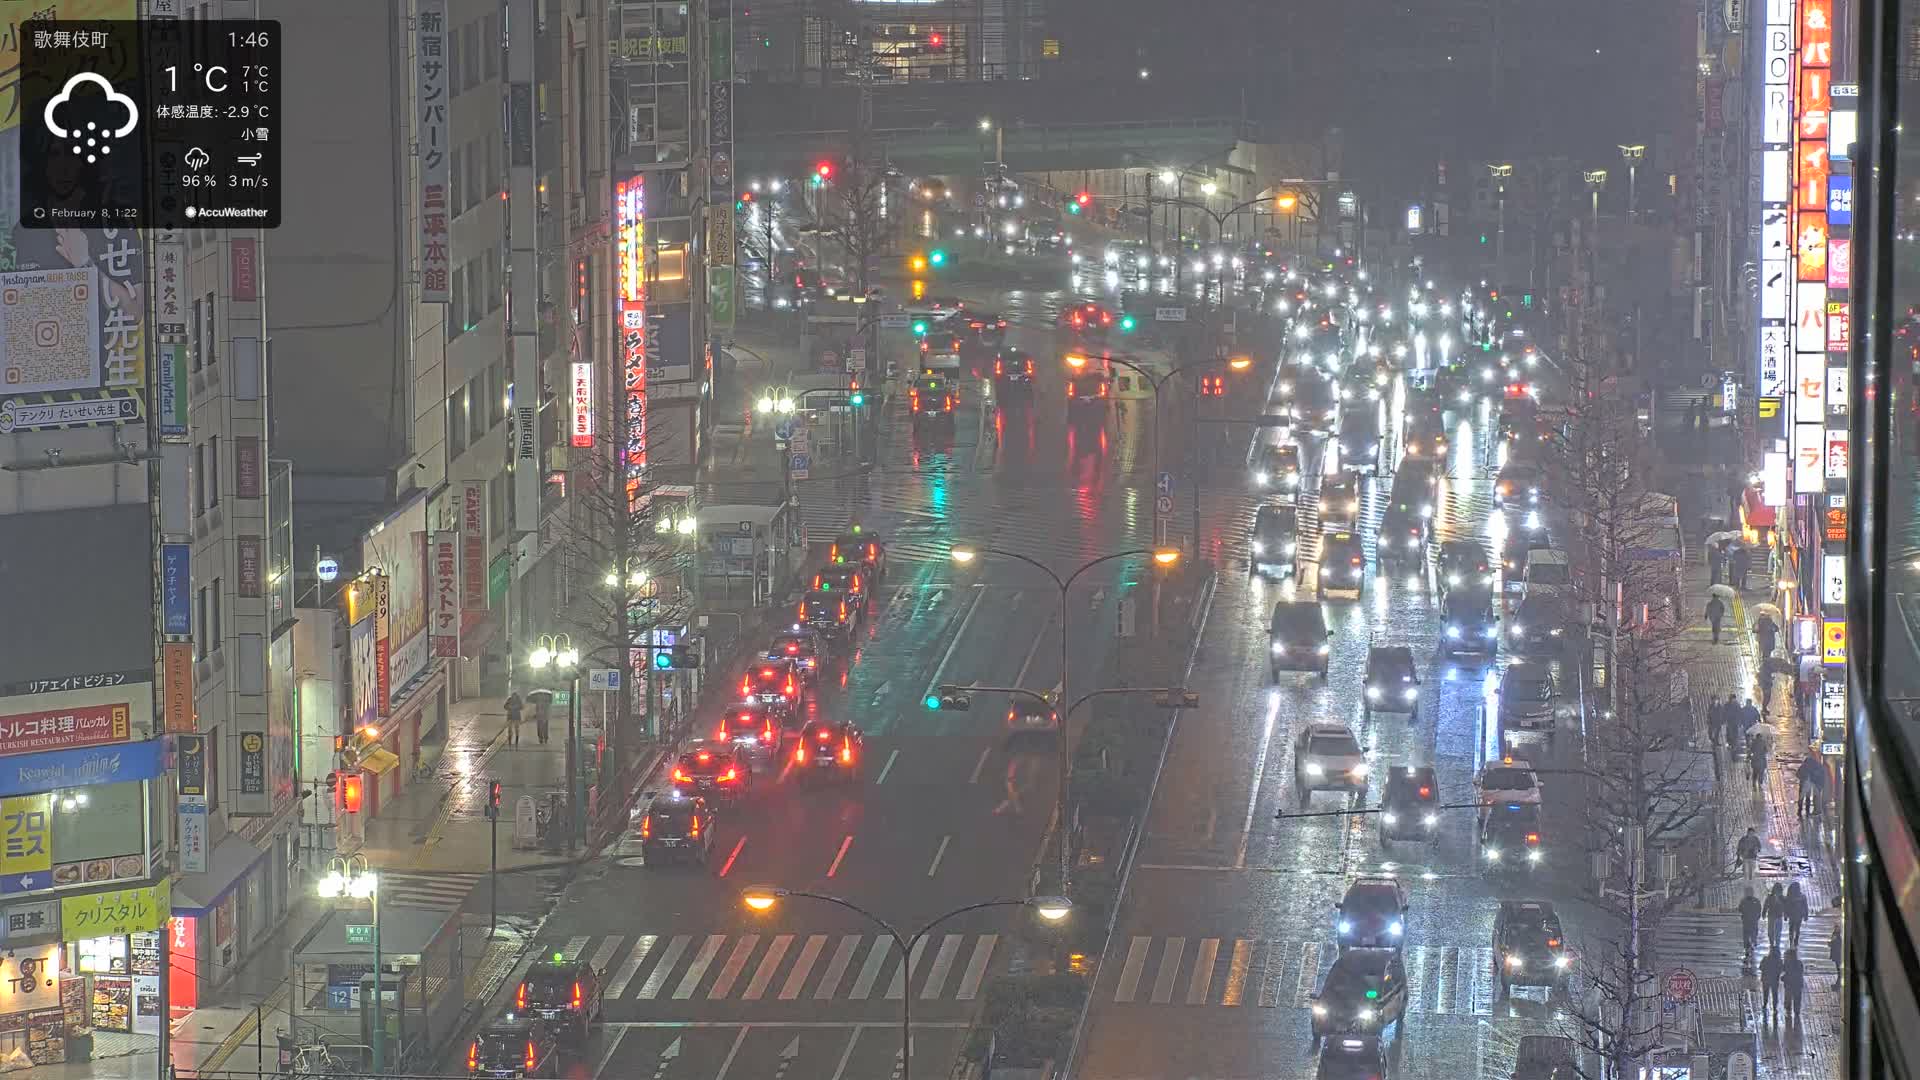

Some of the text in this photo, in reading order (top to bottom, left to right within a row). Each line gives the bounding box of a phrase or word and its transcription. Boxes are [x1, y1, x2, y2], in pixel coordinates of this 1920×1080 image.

[2, 274, 46, 288] Instagram
[163, 324, 181, 333] 3F
[163, 353, 173, 415] FamilyMart
[19, 404, 117, 422] テンクリ たいせい先生
[1833, 497, 1843, 505] 3F
[379, 581, 387, 618] 389
[30, 674, 125, 693] リアエイド ビジョン
[30, 735, 74, 746] RESTAURANT
[5, 813, 44, 834] プロ
[7, 836, 44, 857] ミス
[10, 912, 44, 931] 囲碁
[75, 904, 147, 926] クリスタル
[332, 991, 346, 1003] 12
